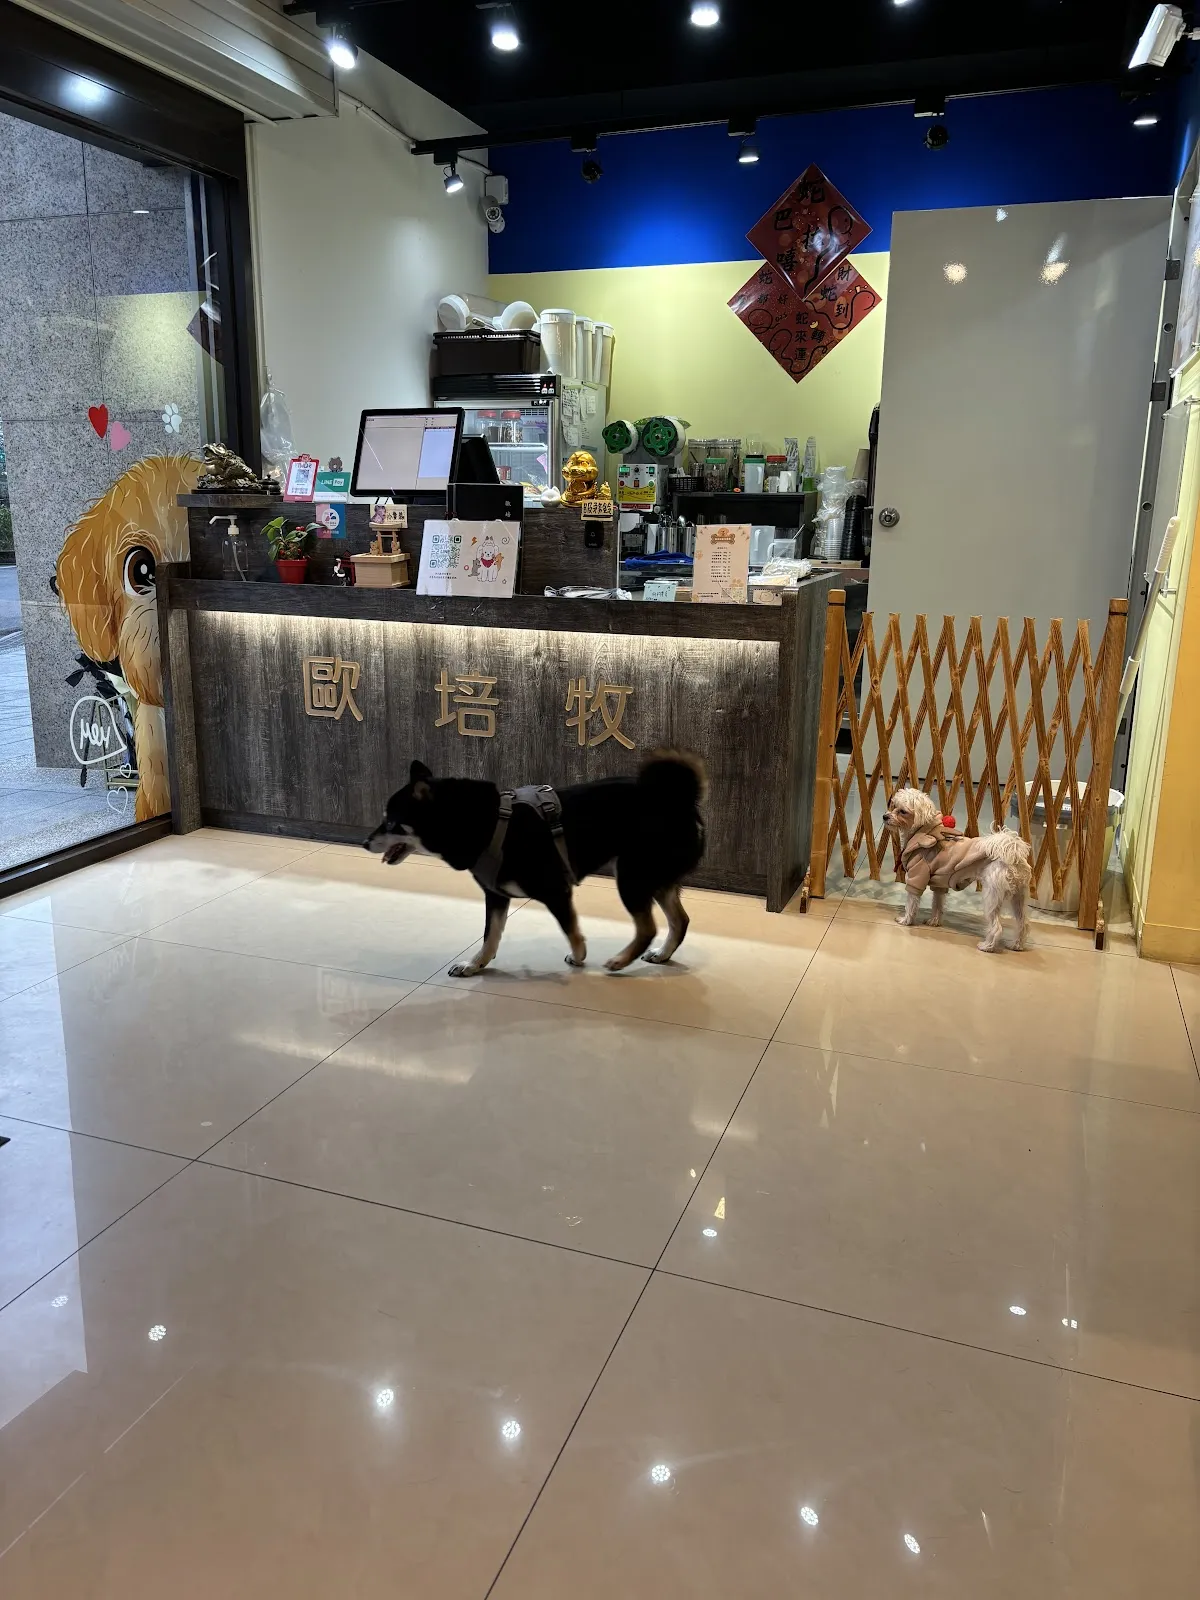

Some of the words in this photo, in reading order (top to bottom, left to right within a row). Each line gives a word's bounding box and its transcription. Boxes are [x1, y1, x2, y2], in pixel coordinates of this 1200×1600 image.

[79, 718, 111, 750] Hey
[303, 655, 635, 750] 歐培牧
